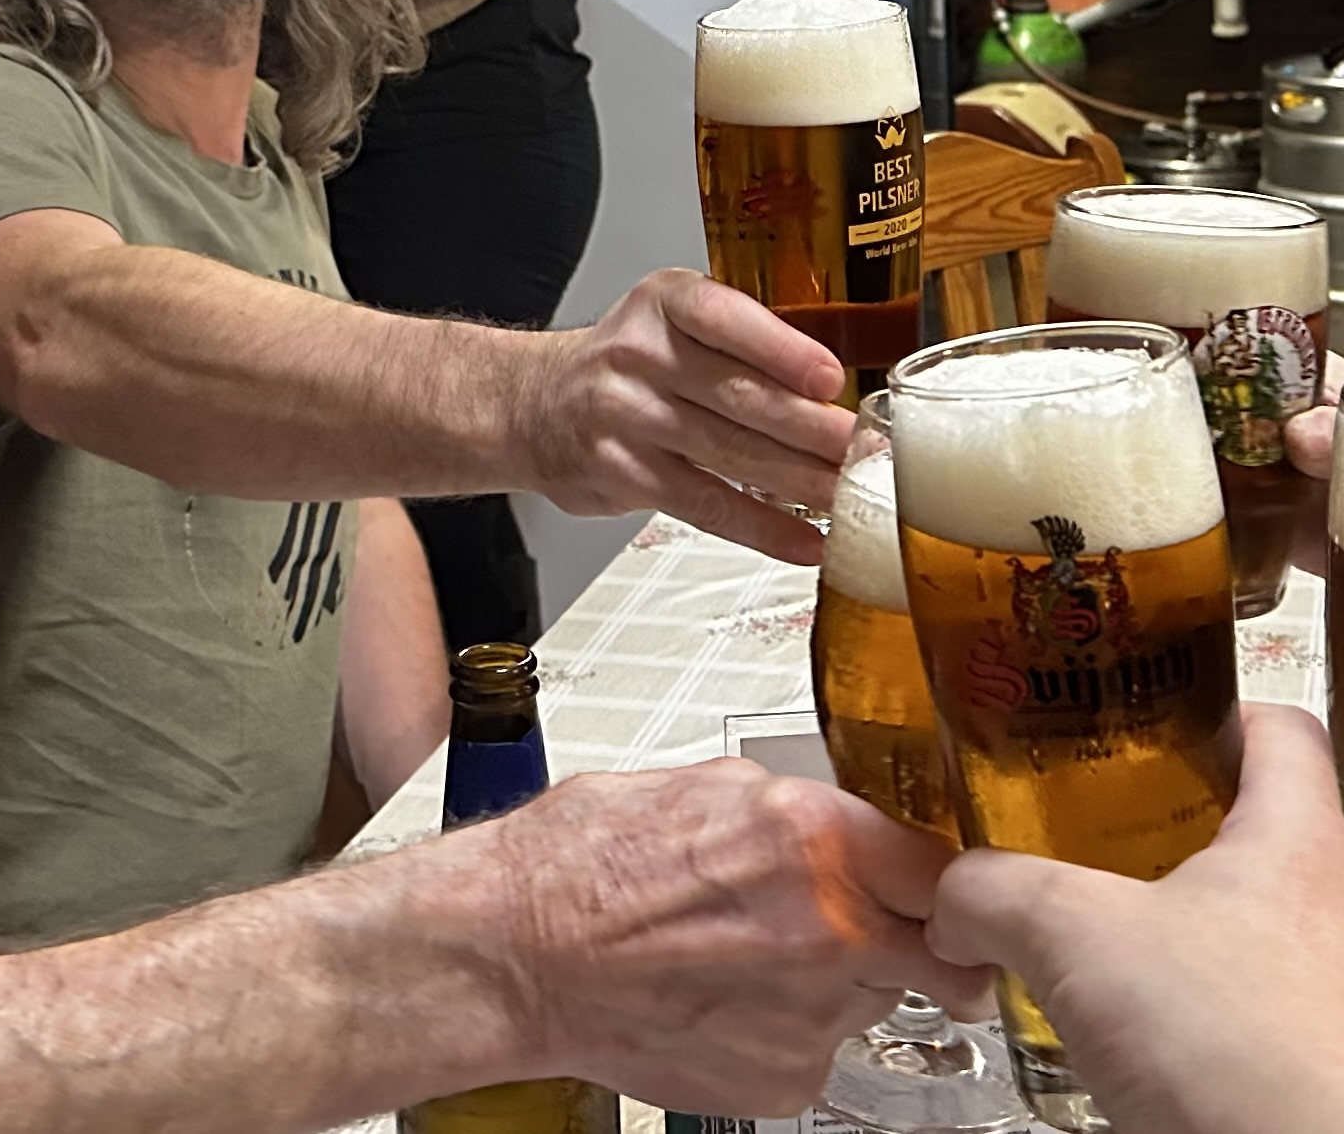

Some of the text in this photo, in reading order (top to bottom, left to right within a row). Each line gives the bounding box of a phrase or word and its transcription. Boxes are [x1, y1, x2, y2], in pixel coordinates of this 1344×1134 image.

[874, 154, 912, 184] BEST
[859, 178, 921, 214] PILSNER
[884, 218, 908, 236] 2020
